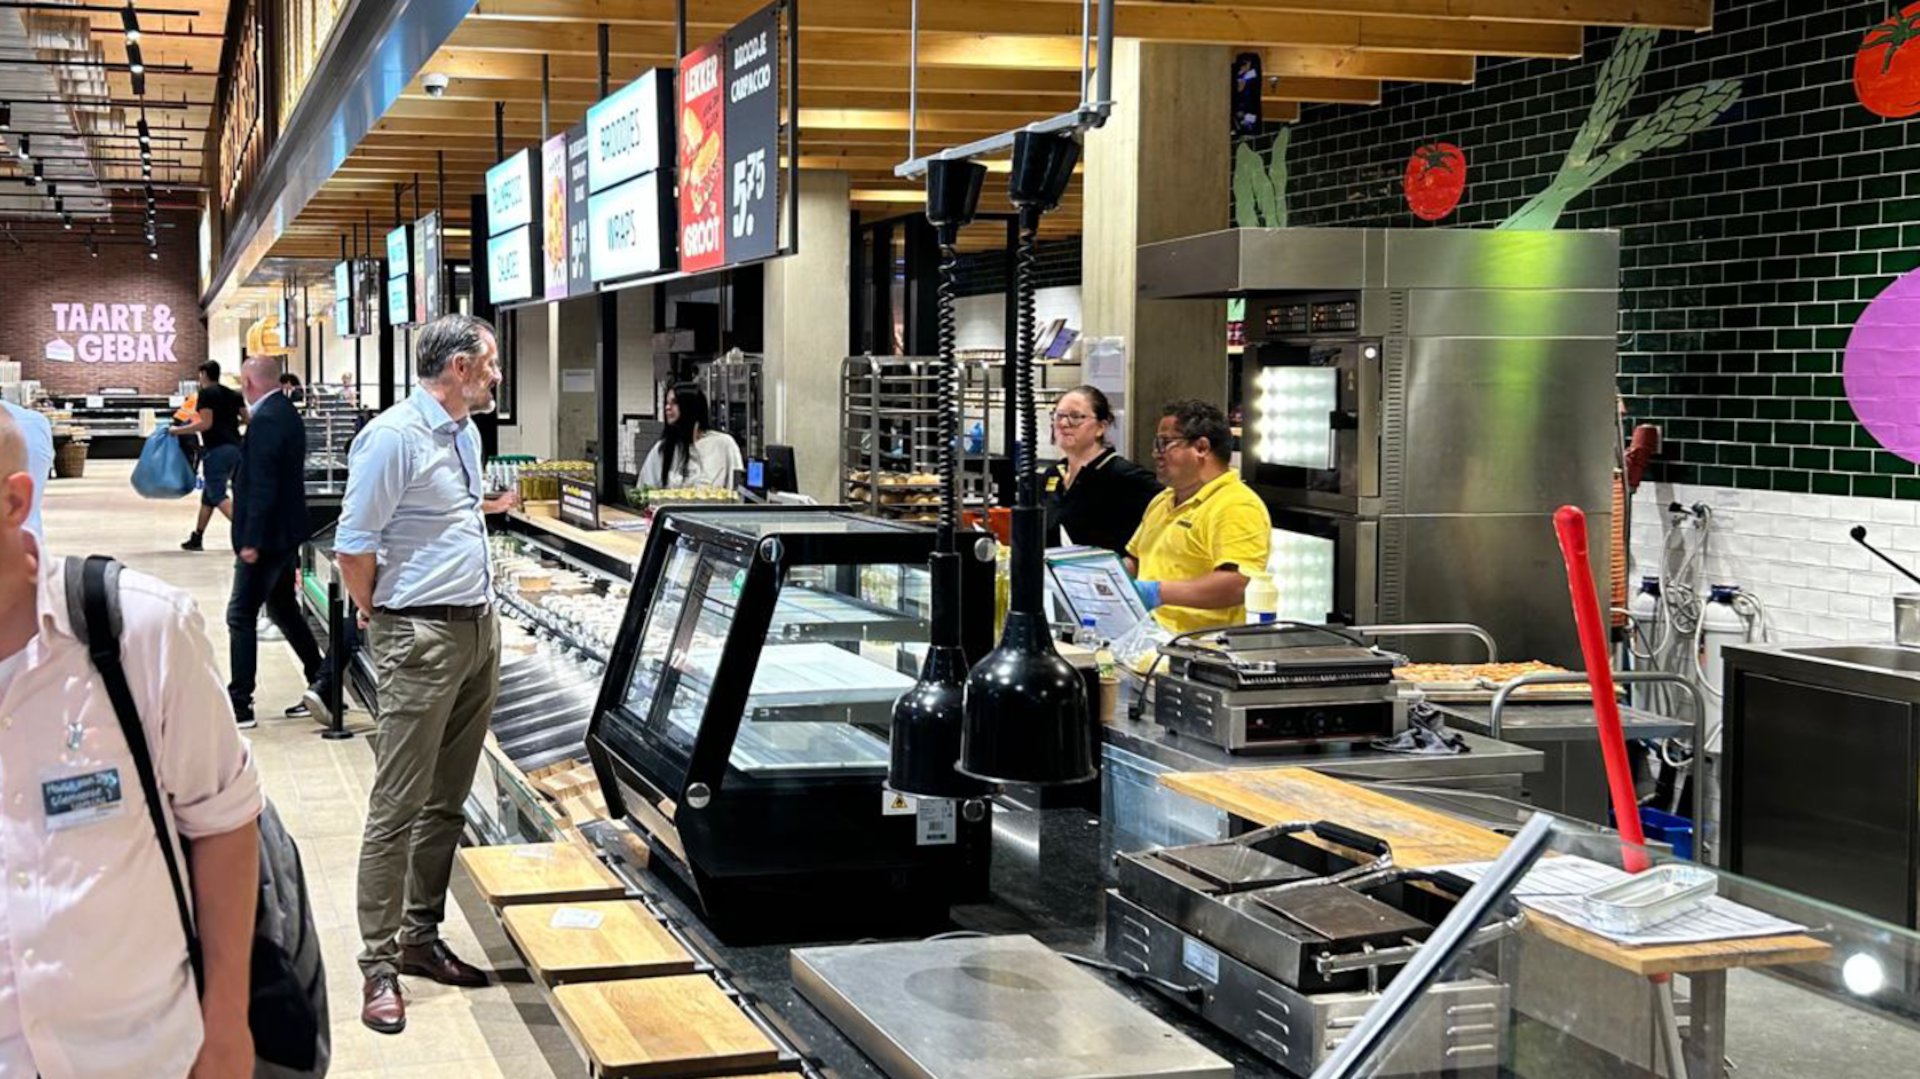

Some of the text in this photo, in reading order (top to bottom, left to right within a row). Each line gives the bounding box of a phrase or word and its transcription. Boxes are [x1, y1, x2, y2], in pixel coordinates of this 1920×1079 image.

[734, 31, 767, 71] BROODJE
[684, 54, 719, 104] LEKKER
[731, 63, 771, 104] CARPACCIO
[600, 108, 641, 162] BROODJES
[607, 209, 637, 251] WRAPS
[683, 215, 720, 258] GROOT
[51, 302, 177, 334] TAART &
[77, 333, 178, 364] GEBAK
